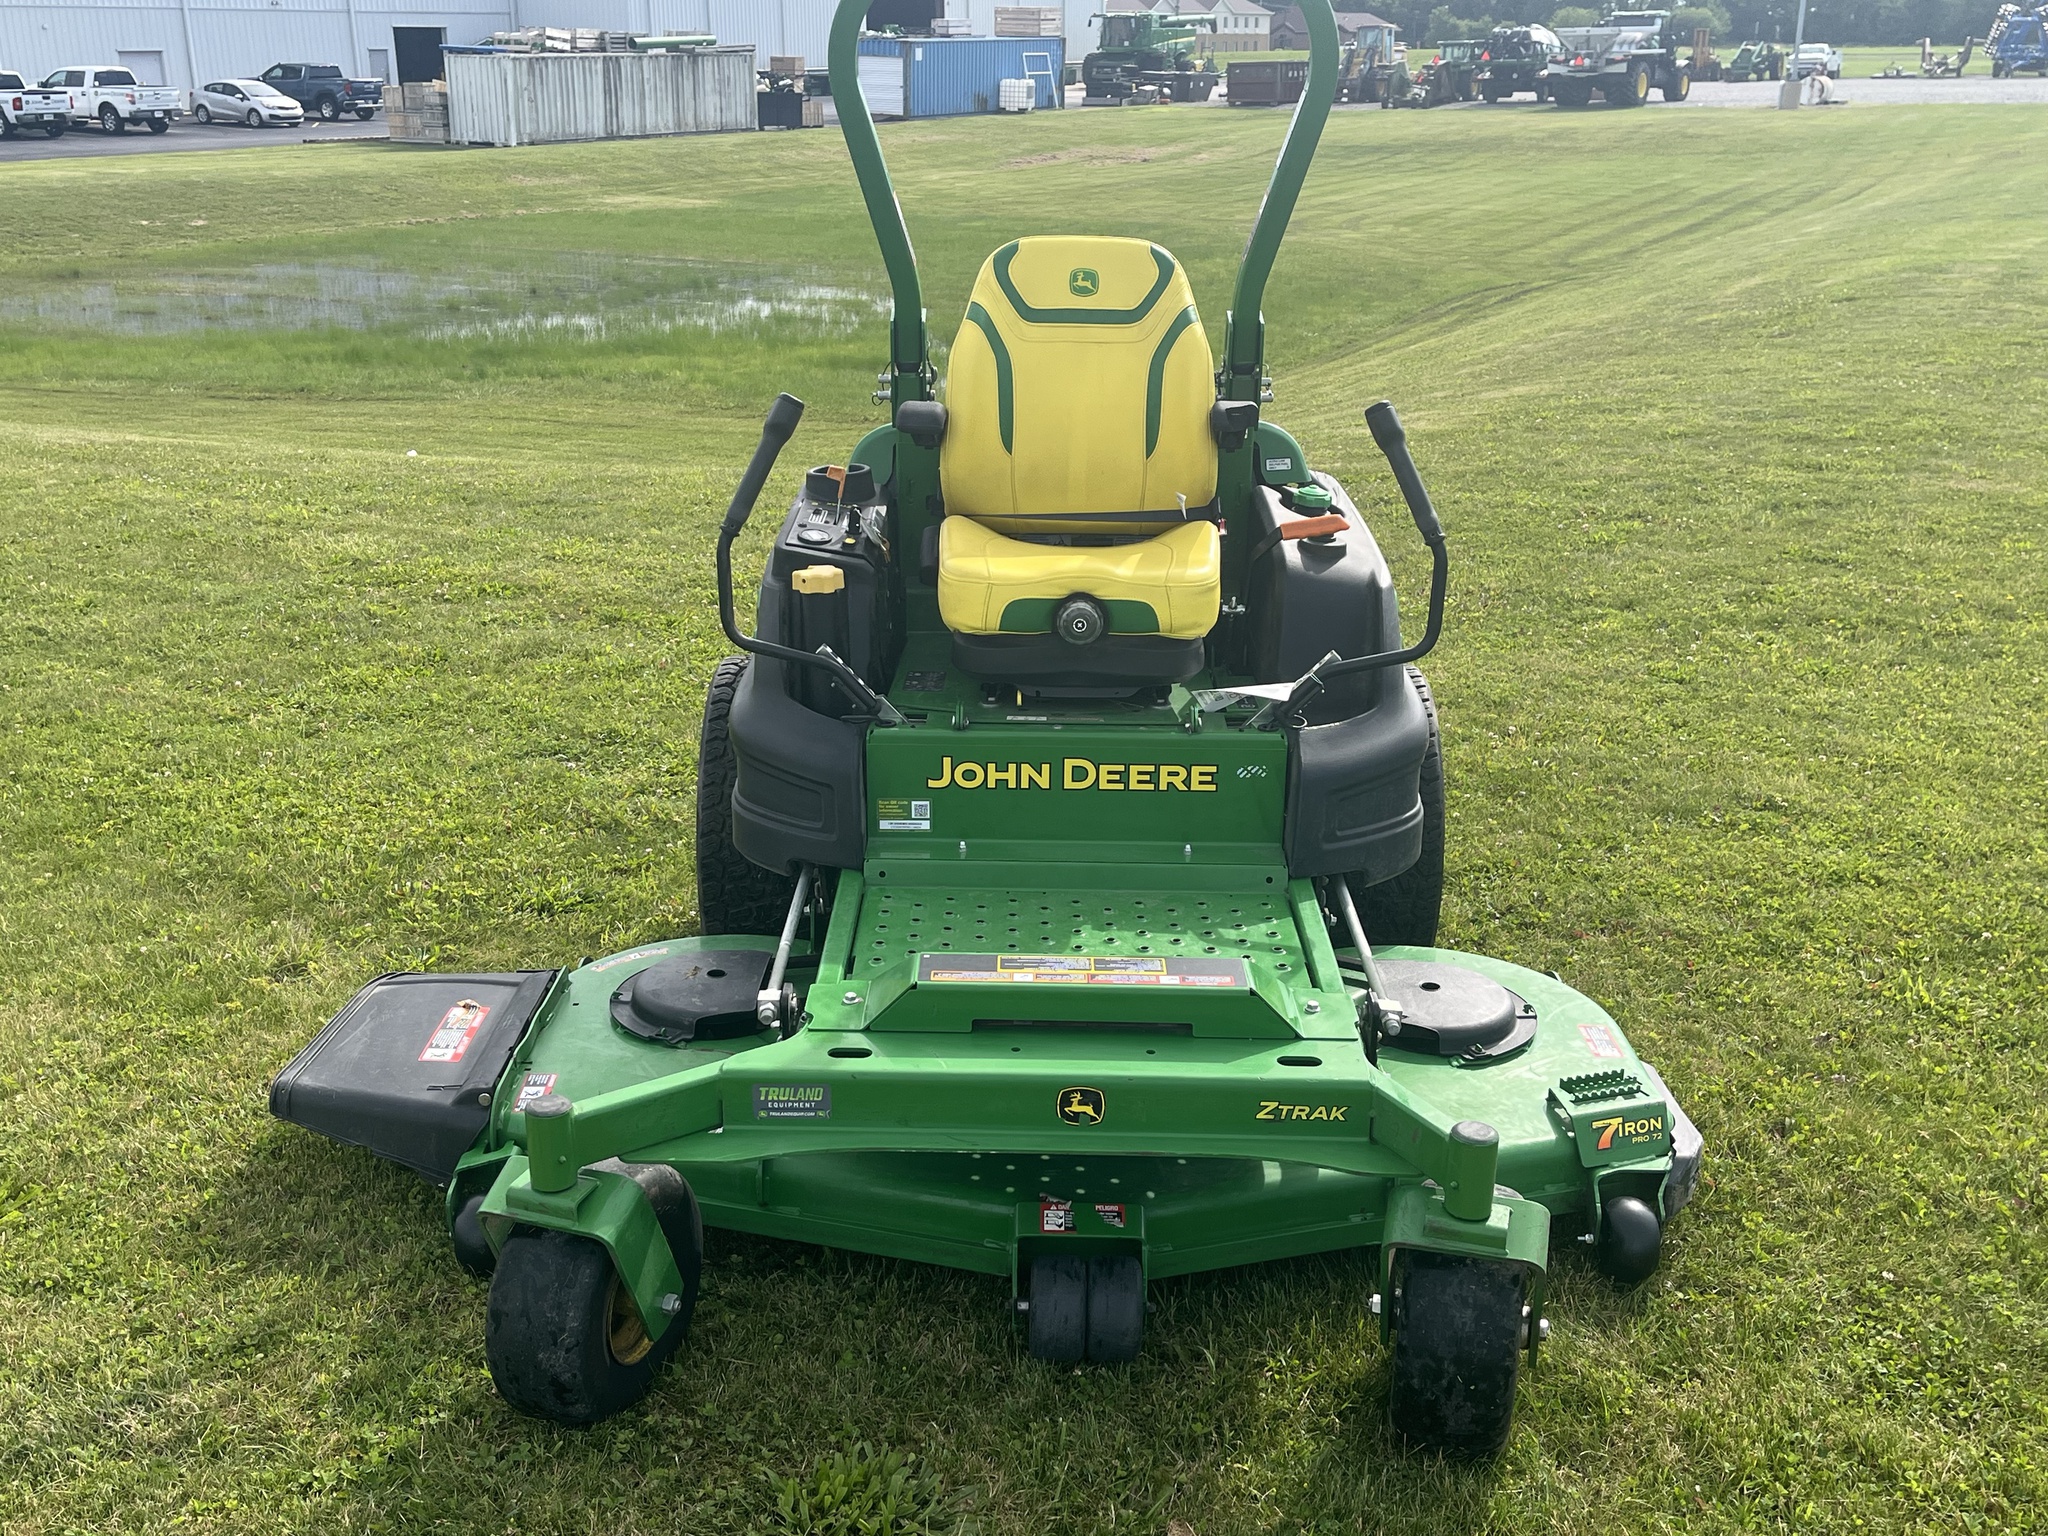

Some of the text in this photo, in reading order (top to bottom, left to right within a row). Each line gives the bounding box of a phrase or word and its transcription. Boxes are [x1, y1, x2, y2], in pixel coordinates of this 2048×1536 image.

[927, 756, 1218, 792] JOHN DEERE
[759, 1087, 824, 1101] TRULAND
[1255, 1101, 1349, 1121] ZTRAK
[1631, 1132, 1663, 1144] PRO 72
